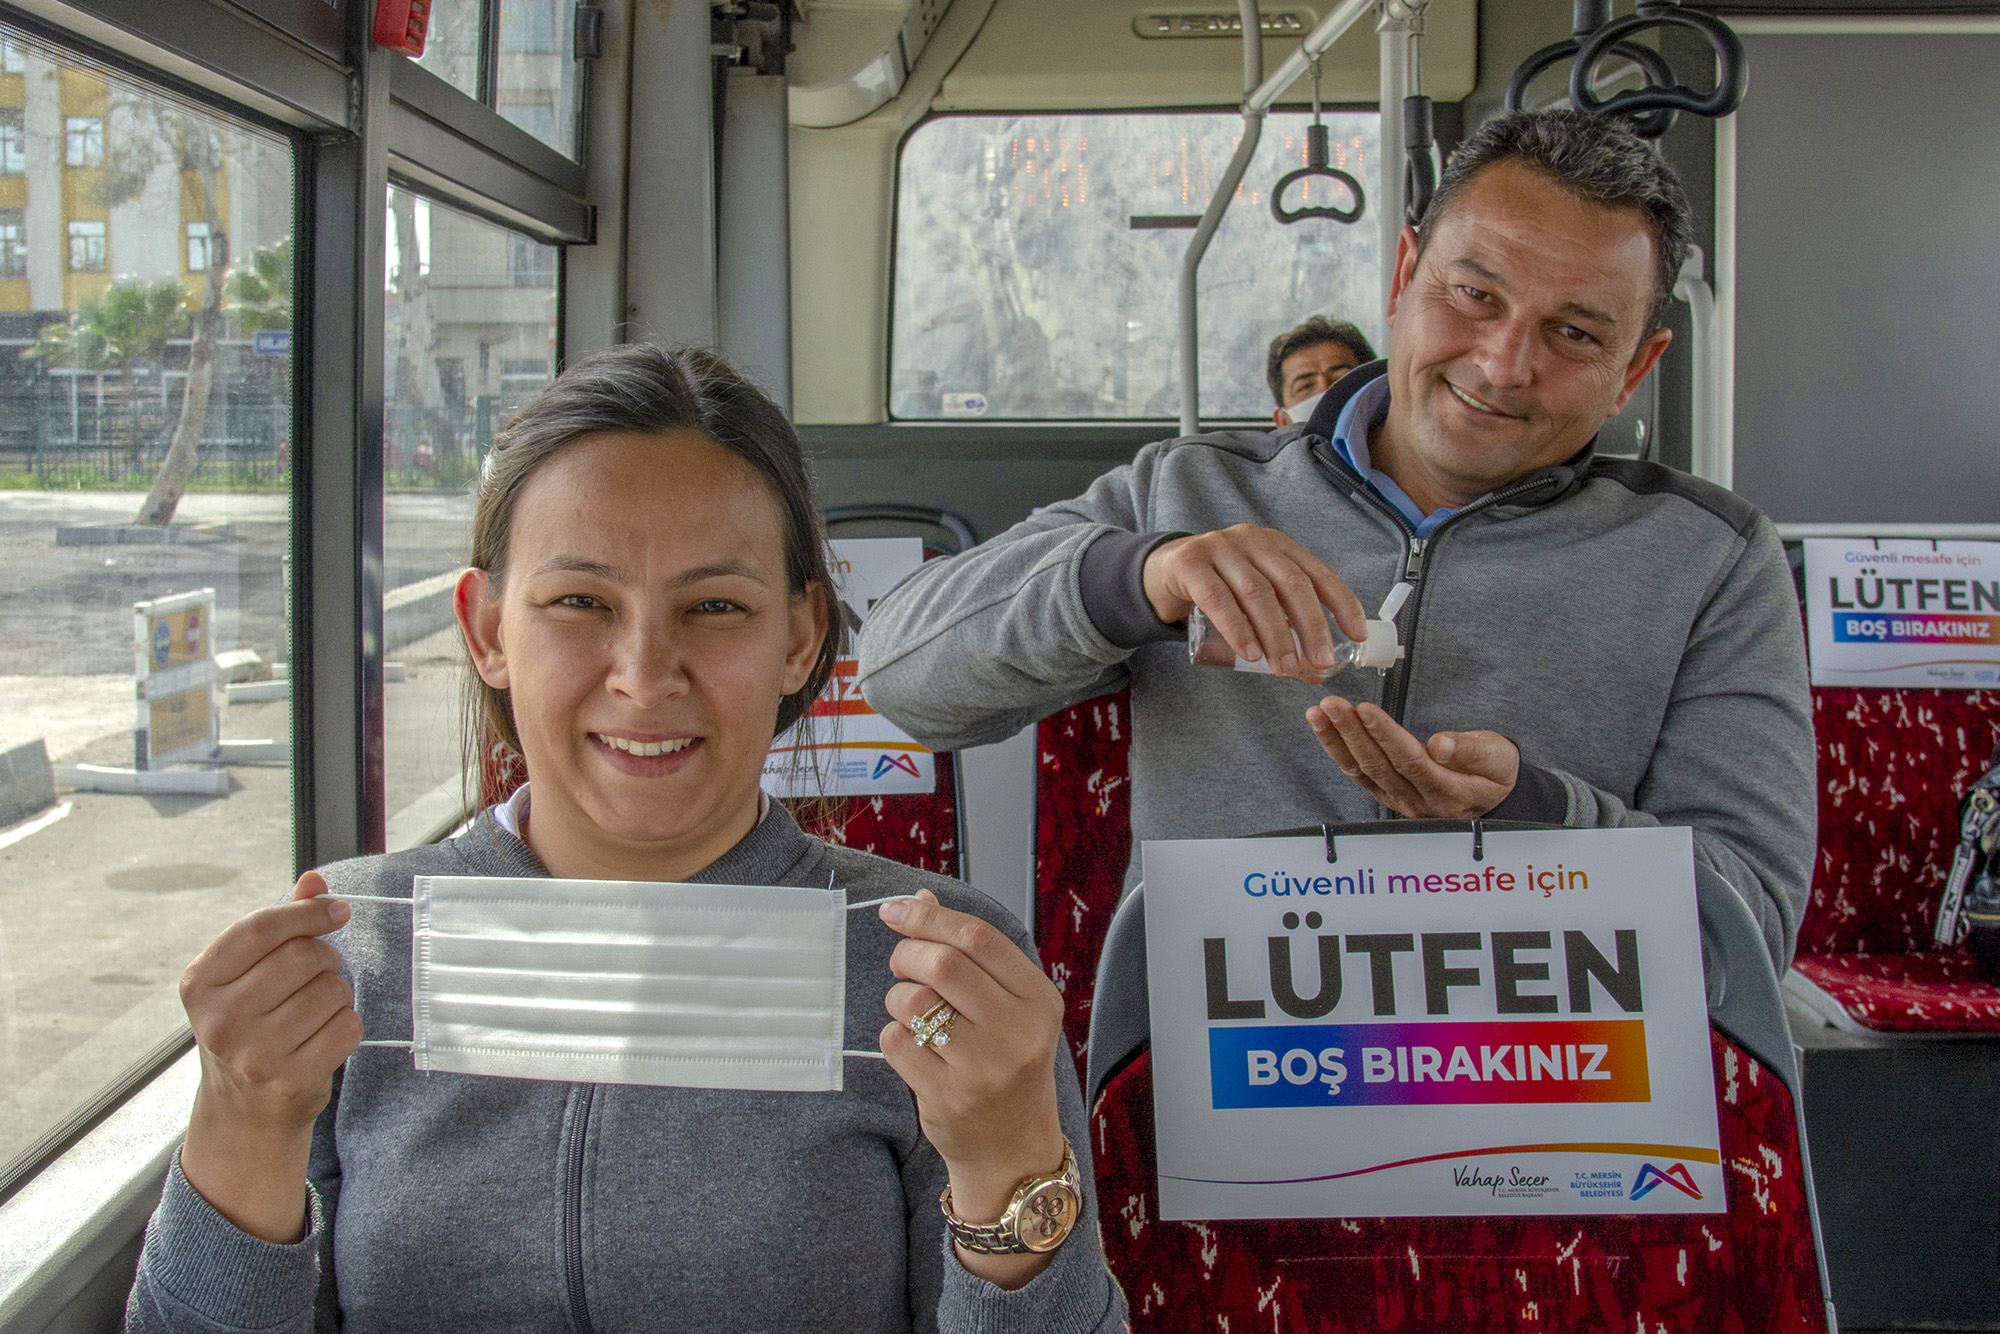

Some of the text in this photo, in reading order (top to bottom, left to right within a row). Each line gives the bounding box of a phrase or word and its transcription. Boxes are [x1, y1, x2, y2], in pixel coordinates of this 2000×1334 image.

[1845, 552, 1982, 567] Güvenli mesafe için
[1829, 568, 2000, 611] LÜTFEN
[1846, 620, 1991, 640] BOŞ BIRAKINIZ
[1244, 864, 1589, 898] Güvenli mesafe için
[1203, 911, 1644, 1020] LÜTFEN
[1247, 1044, 1612, 1095] BOŞ BIRAKINIZ
[1453, 1164, 1550, 1197] Vahap Seçer
[1570, 1180, 1622, 1189] BÜYÜKŞEHİR
[1590, 1170, 1622, 1179] MERSİN
[1580, 1189, 1623, 1197] BELEDİYESİ
